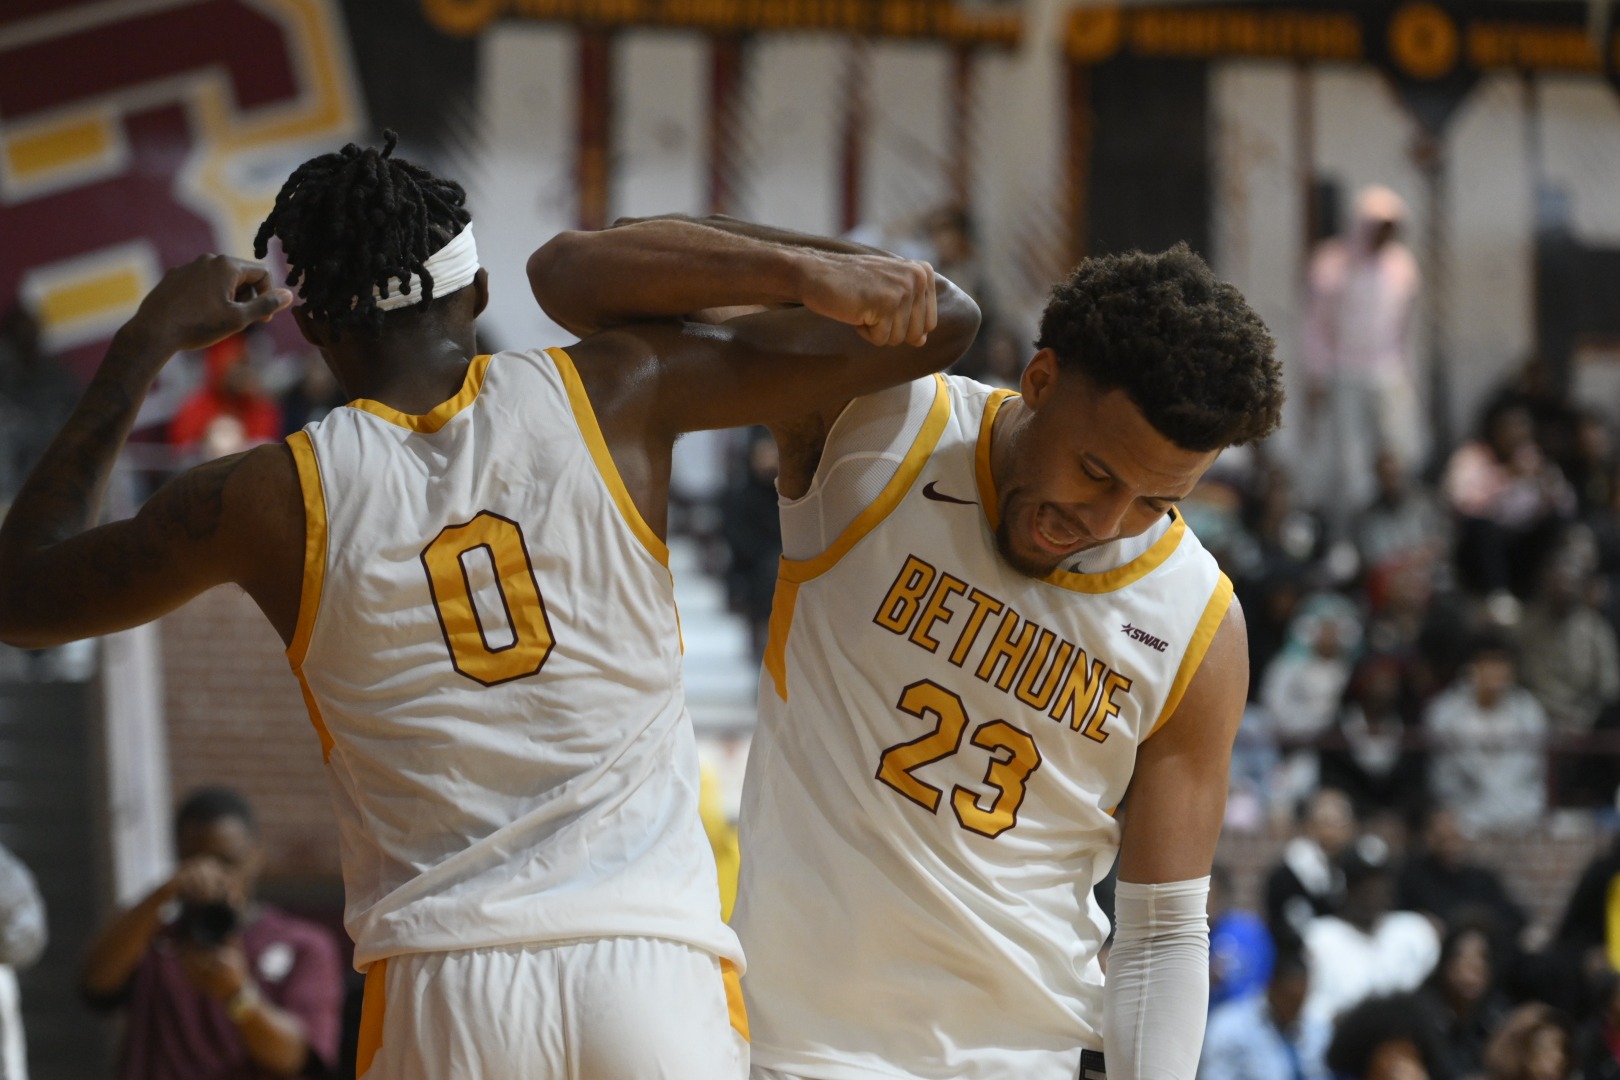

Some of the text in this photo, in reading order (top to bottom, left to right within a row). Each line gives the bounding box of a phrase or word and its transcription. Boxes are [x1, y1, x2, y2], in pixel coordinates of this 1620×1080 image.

[420, 509, 556, 687] 0
[872, 553, 1133, 744] BETHUNE
[1130, 628, 1169, 653] SWAC
[874, 678, 1042, 840] 23
